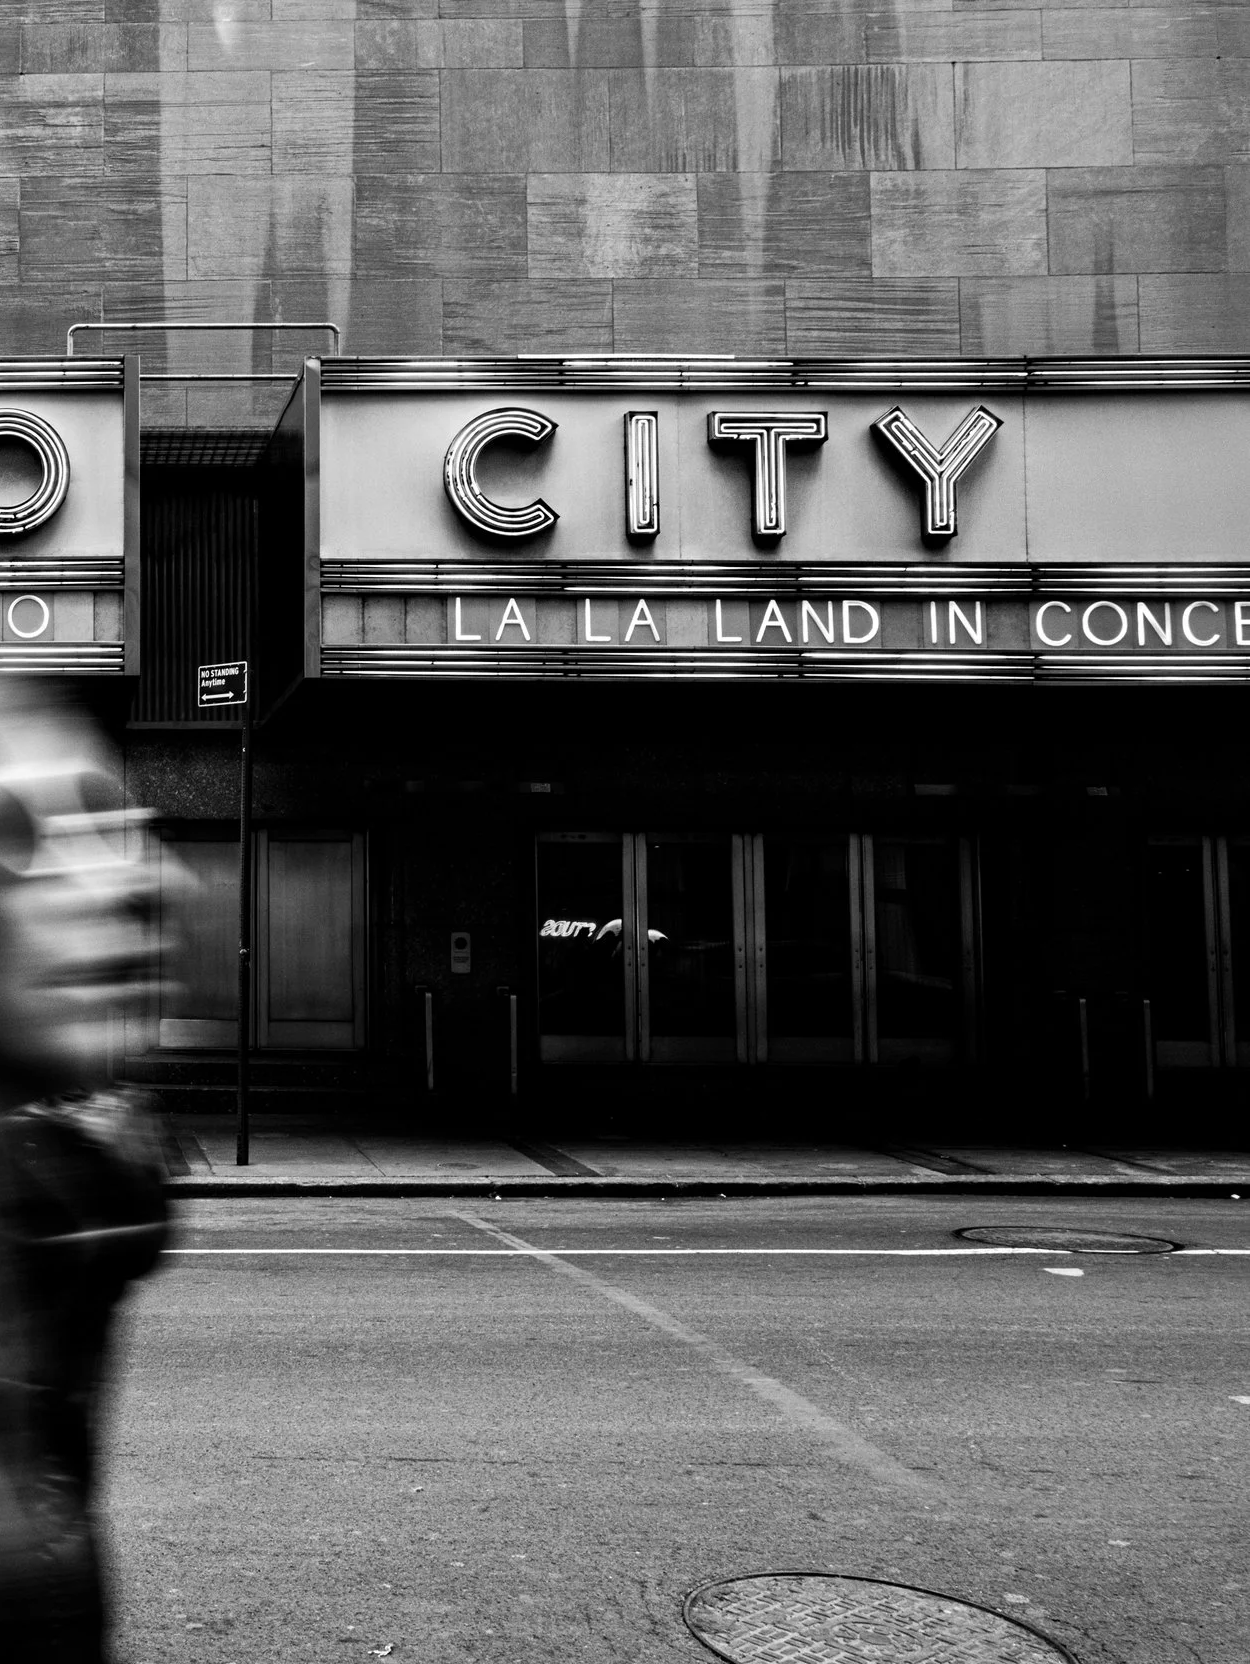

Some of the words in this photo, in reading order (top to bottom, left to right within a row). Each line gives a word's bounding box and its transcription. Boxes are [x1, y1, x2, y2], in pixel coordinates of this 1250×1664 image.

[442, 405, 1004, 546] CITY
[454, 597, 532, 642] LA
[586, 597, 662, 643] LA
[714, 598, 880, 645] LAND
[929, 599, 983, 645] IN
[1035, 600, 1250, 647] CONCE
[201, 670, 210, 678] NO
[210, 667, 239, 678] STANDING
[201, 678, 226, 688] Anytime
